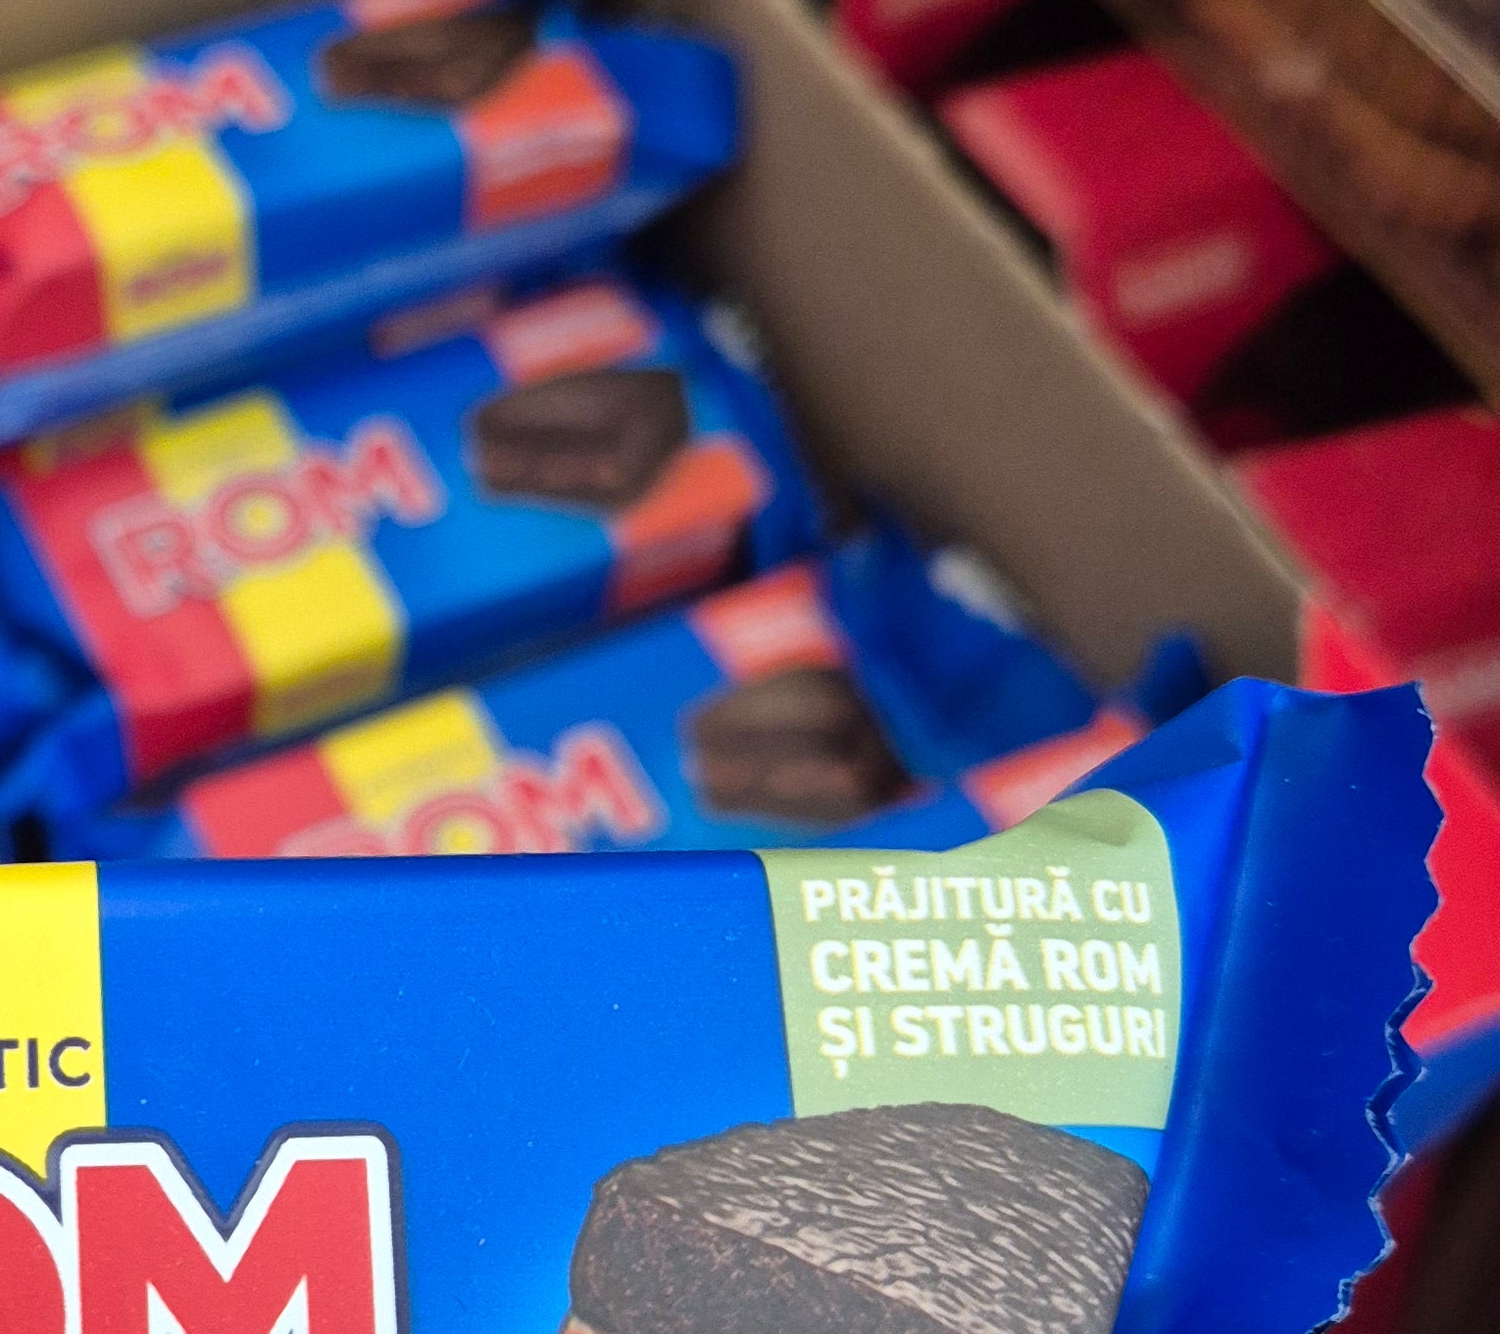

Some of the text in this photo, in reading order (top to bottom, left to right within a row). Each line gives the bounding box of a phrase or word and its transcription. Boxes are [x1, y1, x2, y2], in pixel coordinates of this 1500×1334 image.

[88, 417, 445, 619] ROM
[801, 865, 1152, 925] PRĂJITURĂ CU
[809, 923, 1163, 996] CREMĂ ROM
[890, 1004, 1166, 1060] STRUGURI
